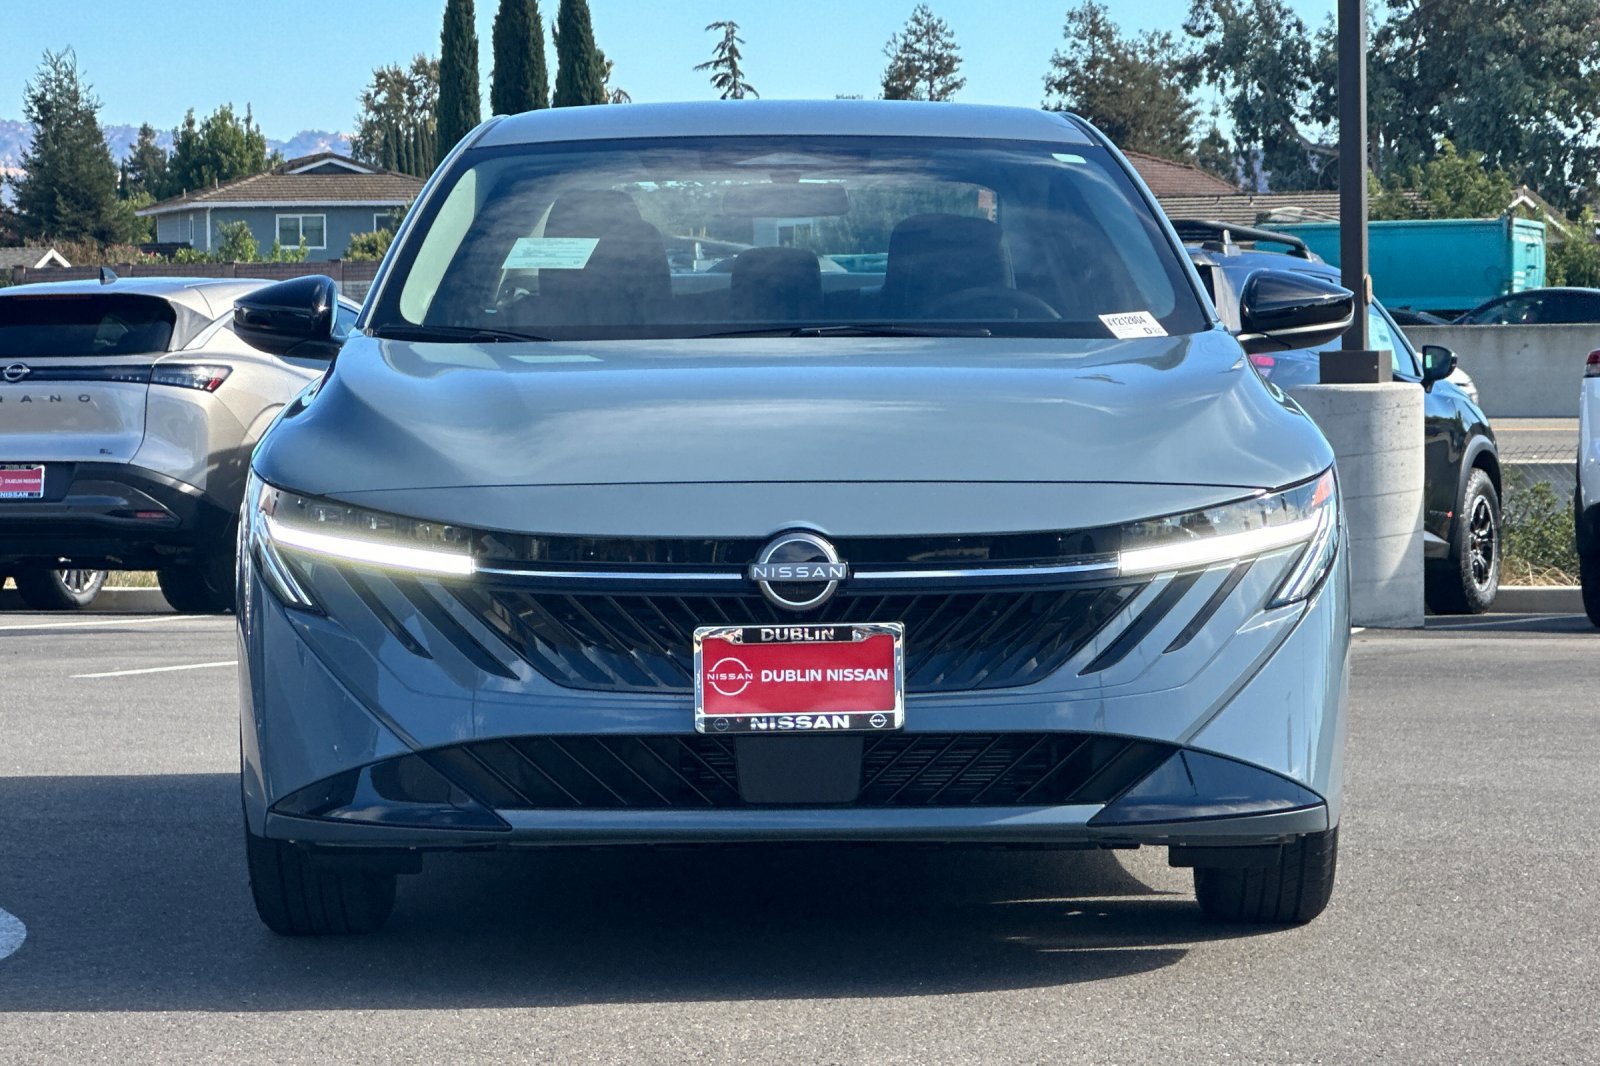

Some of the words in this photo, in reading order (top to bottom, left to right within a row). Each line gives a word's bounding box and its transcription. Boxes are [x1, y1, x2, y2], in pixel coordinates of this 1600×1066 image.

[0, 394, 91, 403] ANO
[753, 566, 844, 578] NISSAN
[760, 627, 835, 641] DUBLIN
[706, 672, 754, 681] NISSAN
[761, 669, 822, 683] DUBLIN
[826, 668, 889, 682] NISSAN
[750, 714, 850, 730] NISSAN
